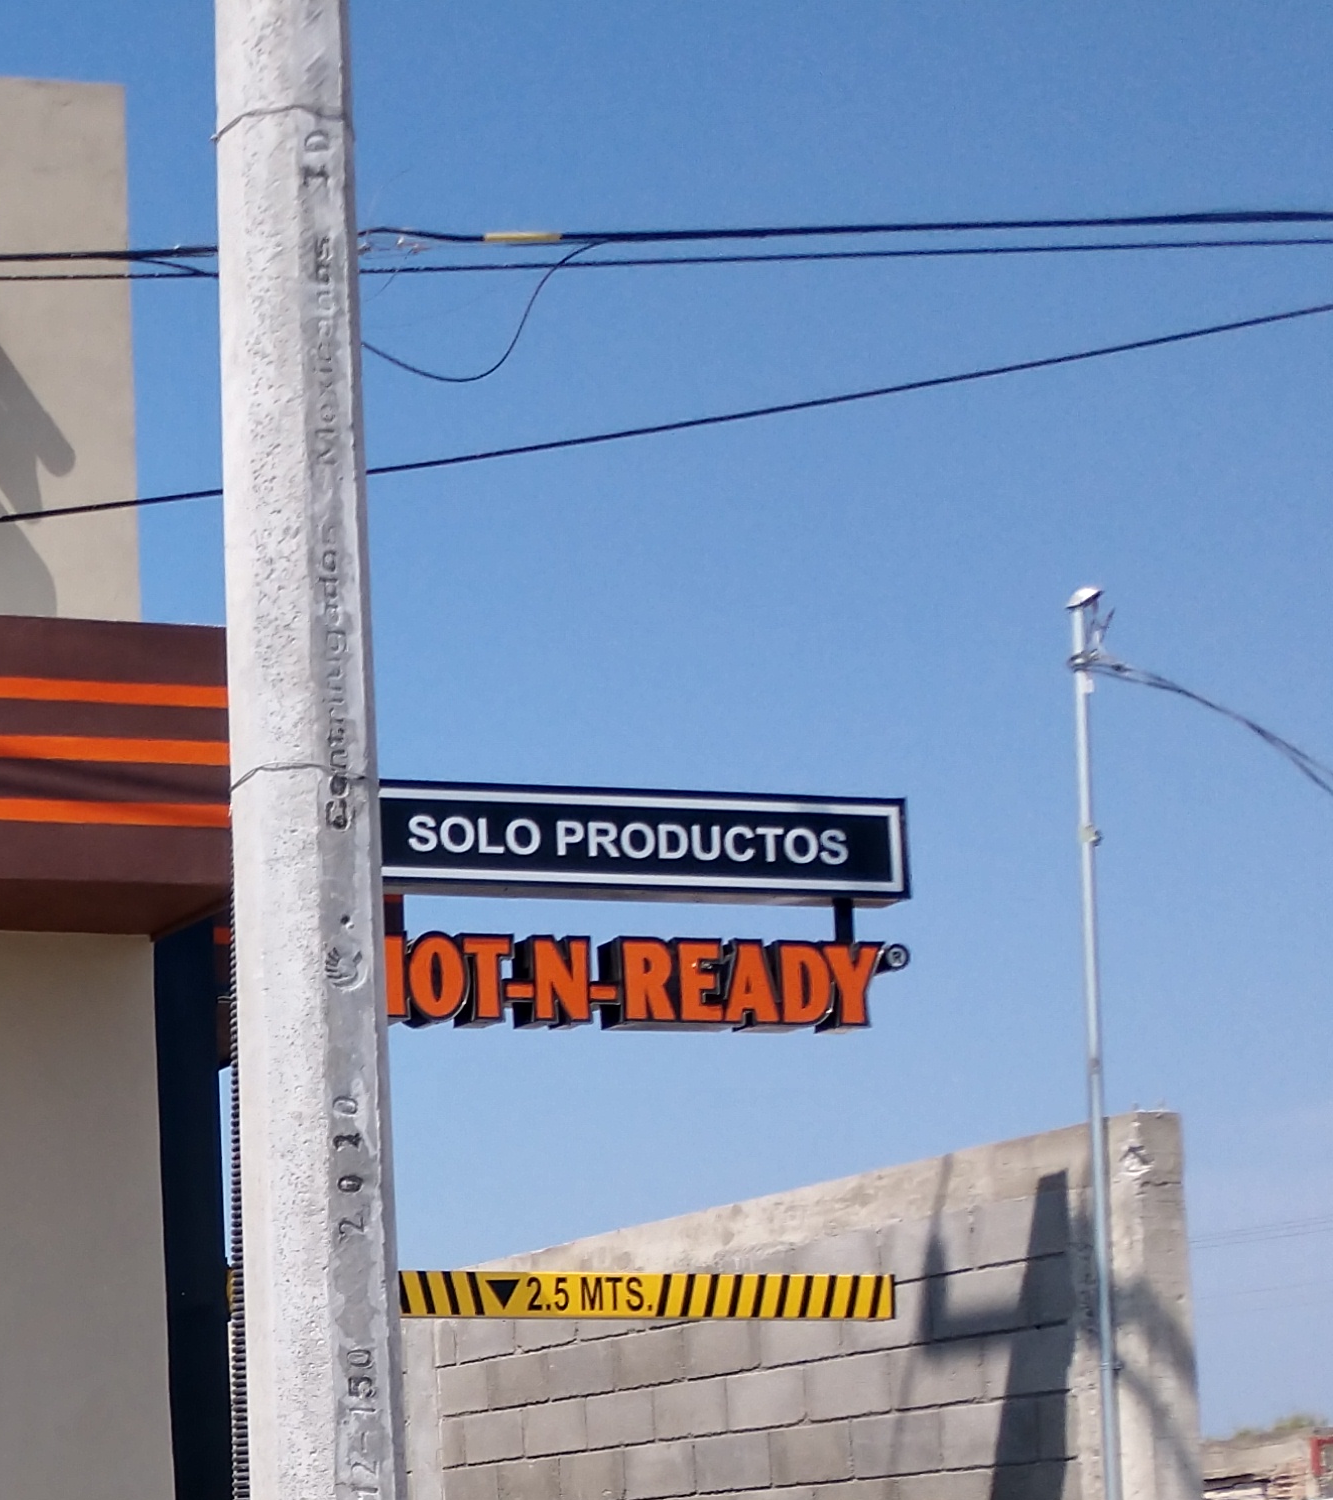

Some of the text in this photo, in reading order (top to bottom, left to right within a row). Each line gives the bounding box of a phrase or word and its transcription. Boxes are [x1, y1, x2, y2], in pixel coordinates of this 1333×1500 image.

[407, 815, 849, 865] SOLO PRODUCTOS
[526, 1276, 654, 1313] 2.5 MTS.
